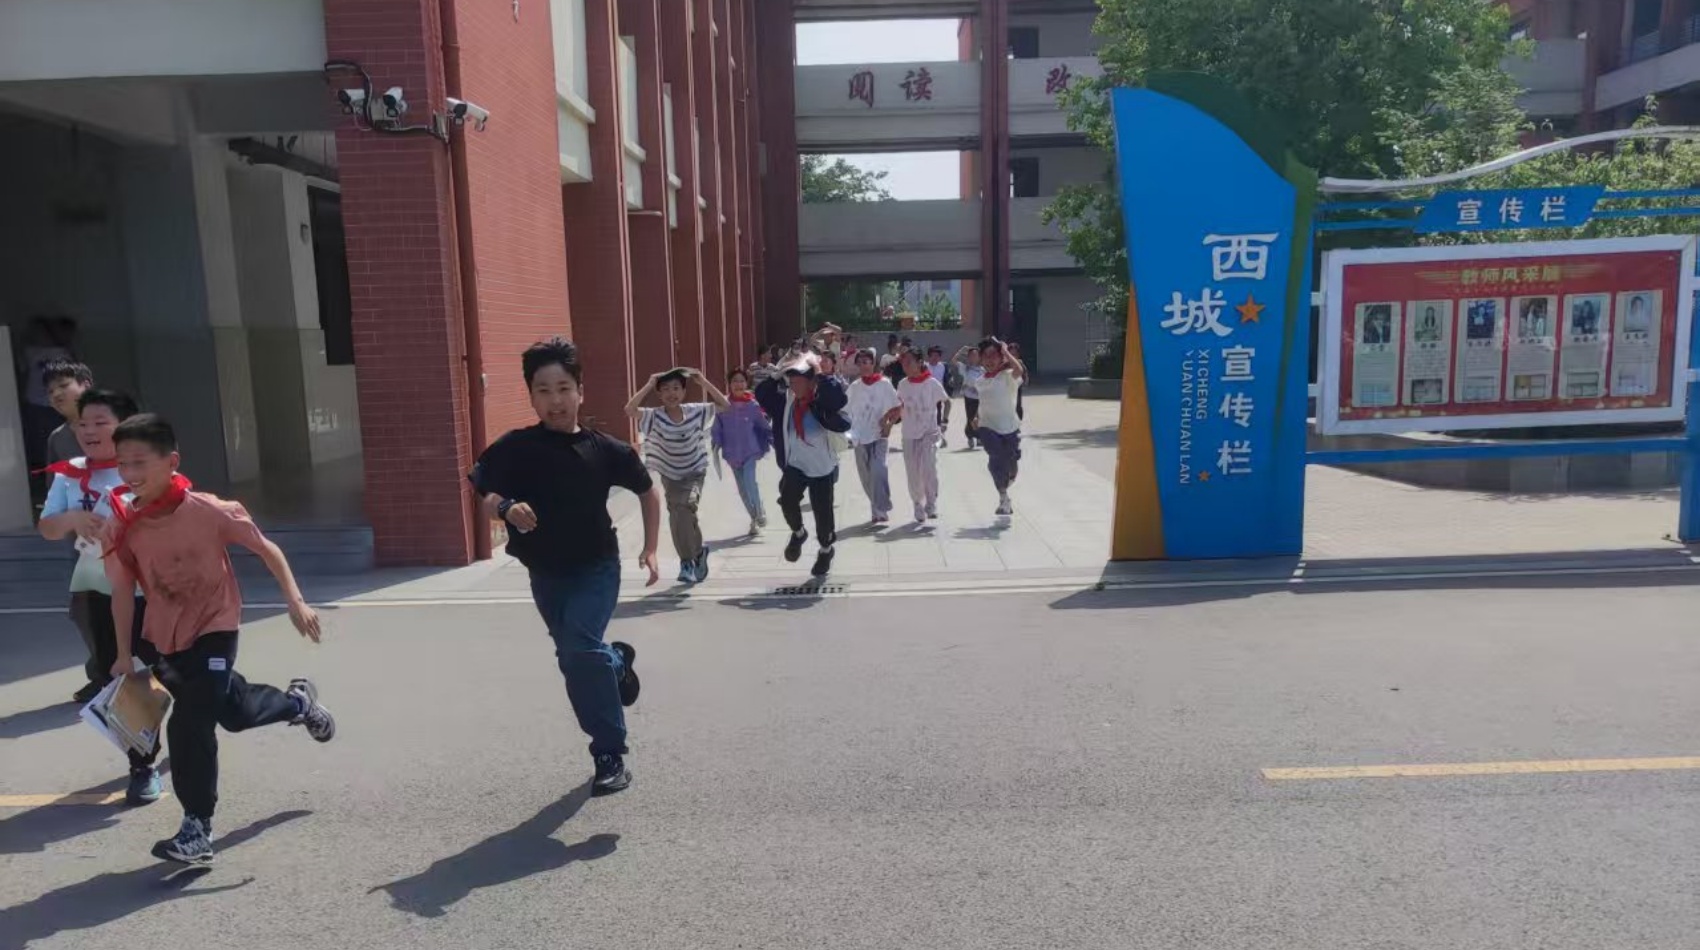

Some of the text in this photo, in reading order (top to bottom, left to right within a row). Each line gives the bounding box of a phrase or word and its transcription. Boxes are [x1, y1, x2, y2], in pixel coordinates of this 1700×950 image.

[849, 67, 933, 108] 阅读
[1456, 195, 1567, 225] 宣传栏
[1160, 233, 1279, 337] 西城
[1217, 344, 1256, 476] 宣传栏
